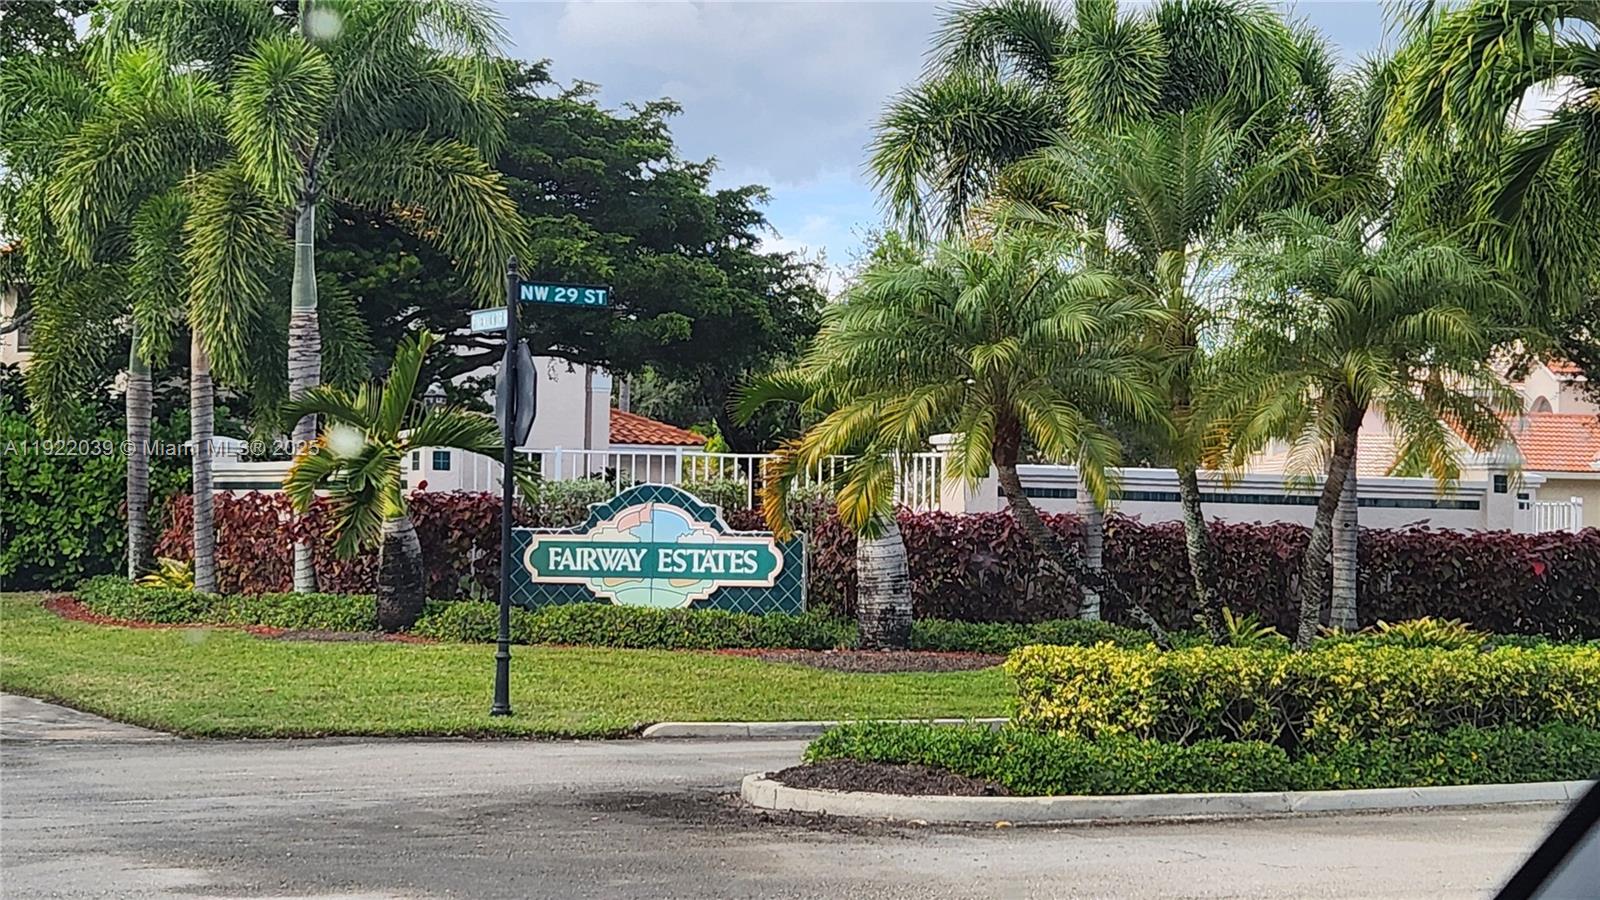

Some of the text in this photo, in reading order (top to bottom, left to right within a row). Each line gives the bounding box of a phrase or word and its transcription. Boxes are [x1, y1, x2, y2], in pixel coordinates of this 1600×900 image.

[520, 285, 606, 304] NW 29 ST
[548, 547, 758, 573] FAIRWAY ESTATES
